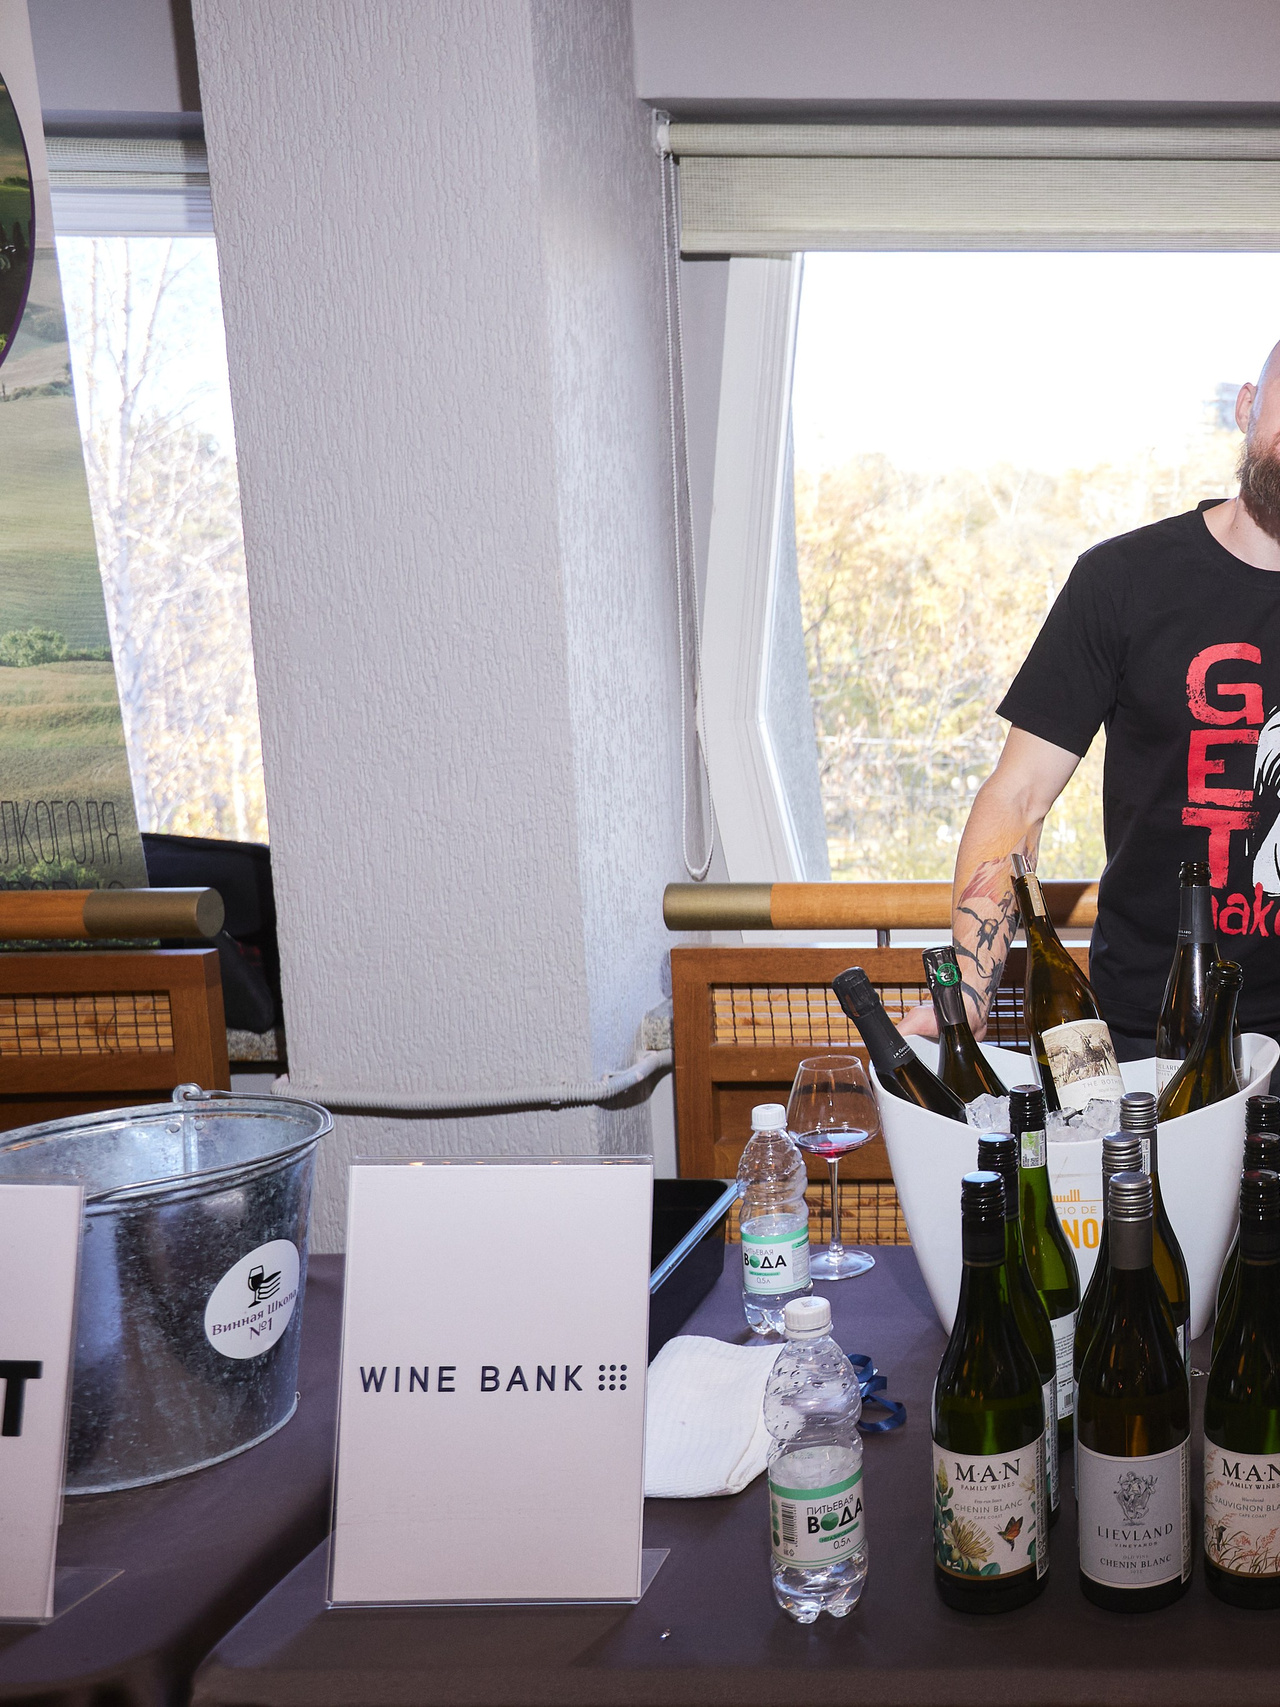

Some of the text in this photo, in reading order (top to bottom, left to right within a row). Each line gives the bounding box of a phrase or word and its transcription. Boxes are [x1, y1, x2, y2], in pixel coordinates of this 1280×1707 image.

[1181, 642, 1264, 889] GET
[0, 800, 122, 864] ЛКОГОЛЯ
[1081, 1206, 1097, 1215] DE
[1061, 1218, 1103, 1250] NO
[212, 1289, 297, 1336] Винная Школа
[360, 1365, 583, 1393] WINE BANK
[961, 1481, 1016, 1492] FAMILY WINES
[1226, 1480, 1280, 1490] FAMILY WINES
[807, 1494, 854, 1516] ПИТЬЕВАЯ
[954, 1499, 1023, 1514] CHENIN BLANC
[1214, 1495, 1263, 1513] SAUVIGNON
[807, 1498, 863, 1534] ВОДА
[1097, 1522, 1174, 1542] LIEVLAND
[1114, 1541, 1158, 1549] VINEYARDS
[1100, 1553, 1172, 1569] CHENIN BLANC
